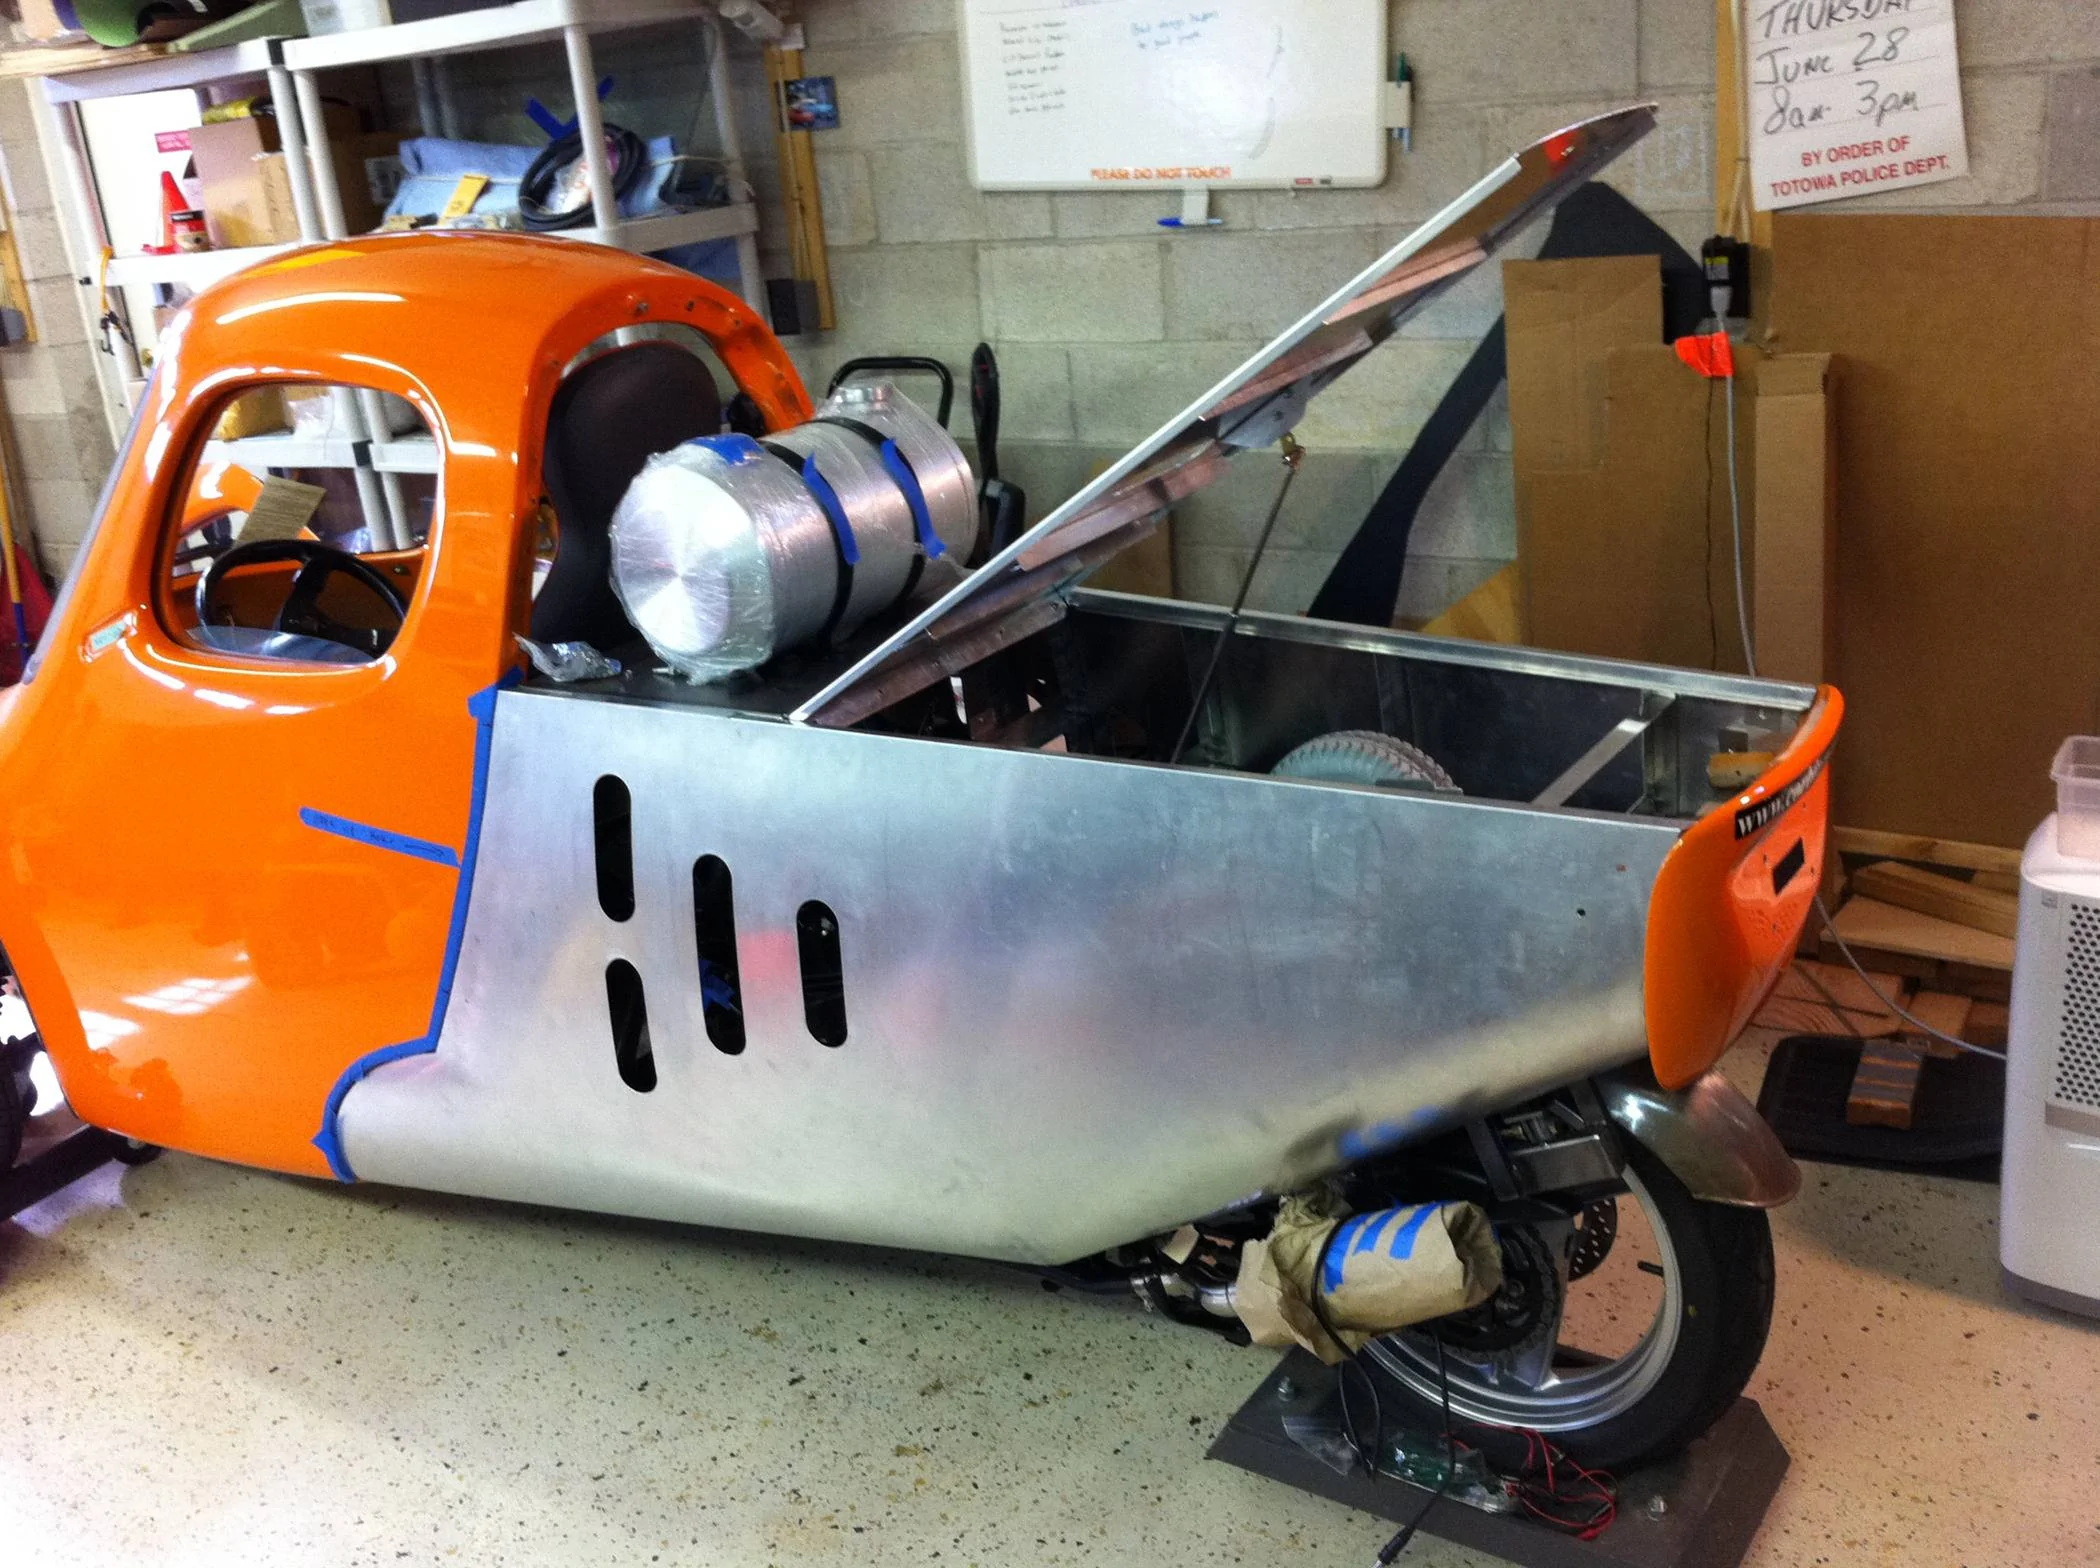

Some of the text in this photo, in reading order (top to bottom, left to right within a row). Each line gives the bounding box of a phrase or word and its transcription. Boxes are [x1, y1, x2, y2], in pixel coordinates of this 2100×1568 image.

[1853, 27, 1909, 66] 28
[1801, 136, 1911, 167] BY ORDER OF
[1091, 166, 1231, 180] PLEASE DO NOT TOUCH
[1771, 155, 1950, 197] TOTOWA POLICE DEPT.
